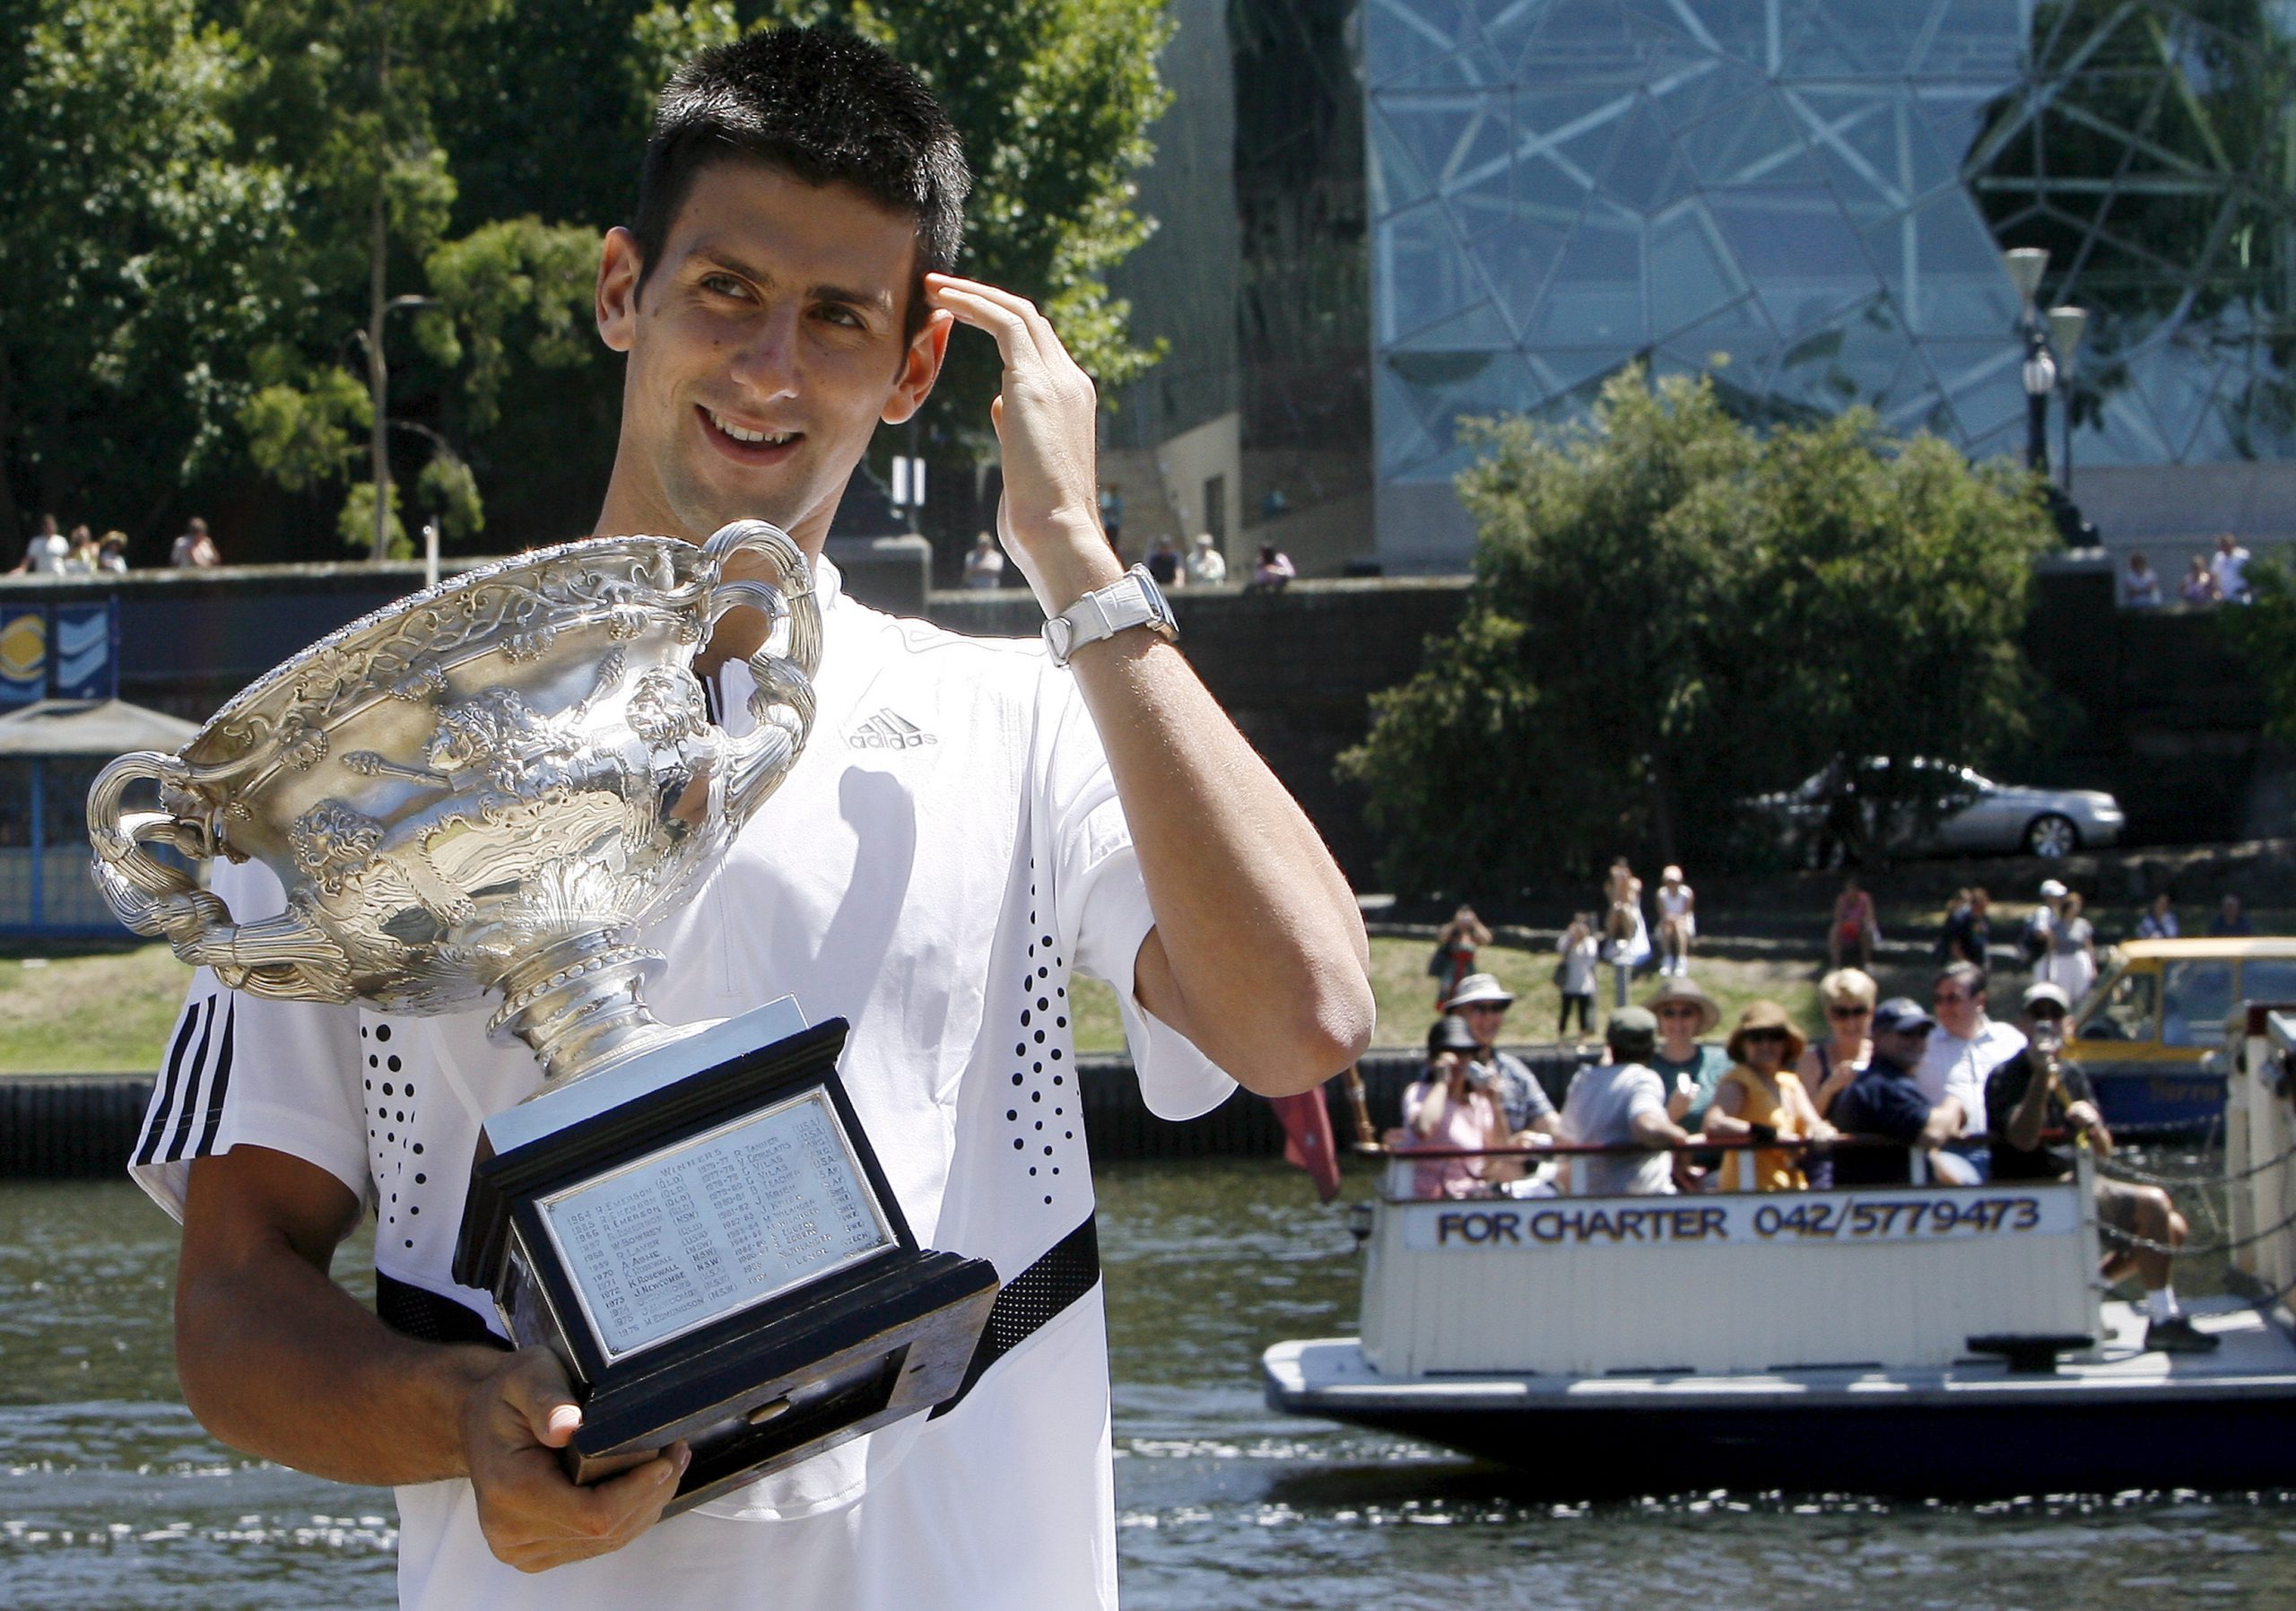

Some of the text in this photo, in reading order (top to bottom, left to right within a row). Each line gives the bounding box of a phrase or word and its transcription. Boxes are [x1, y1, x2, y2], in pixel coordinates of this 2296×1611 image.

[848, 731, 938, 751] adidas
[659, 1145, 722, 1178] WINNERS
[1437, 1196, 2041, 1248] FOR CHARTER 042/5779473
